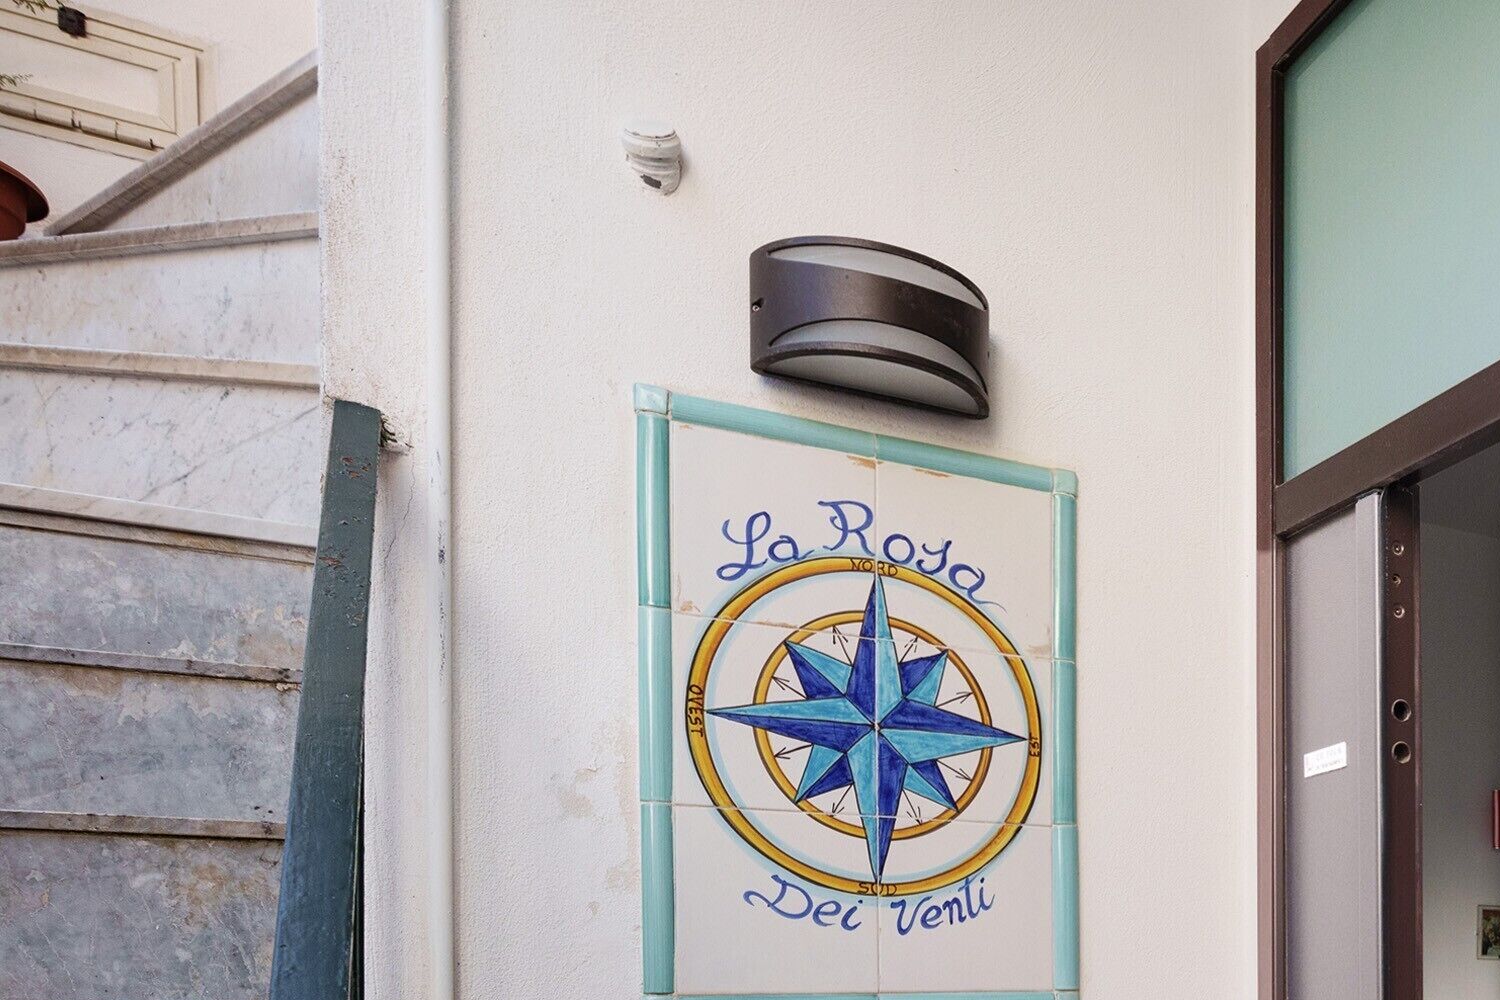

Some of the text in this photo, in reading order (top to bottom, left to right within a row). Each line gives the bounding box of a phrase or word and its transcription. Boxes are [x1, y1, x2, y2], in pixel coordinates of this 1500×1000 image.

[716, 500, 1007, 612] La Rosa
[850, 558, 899, 576] NORD
[689, 684, 704, 737] OVEST
[1029, 732, 1040, 757] EST
[743, 874, 995, 936] Dei Venti
